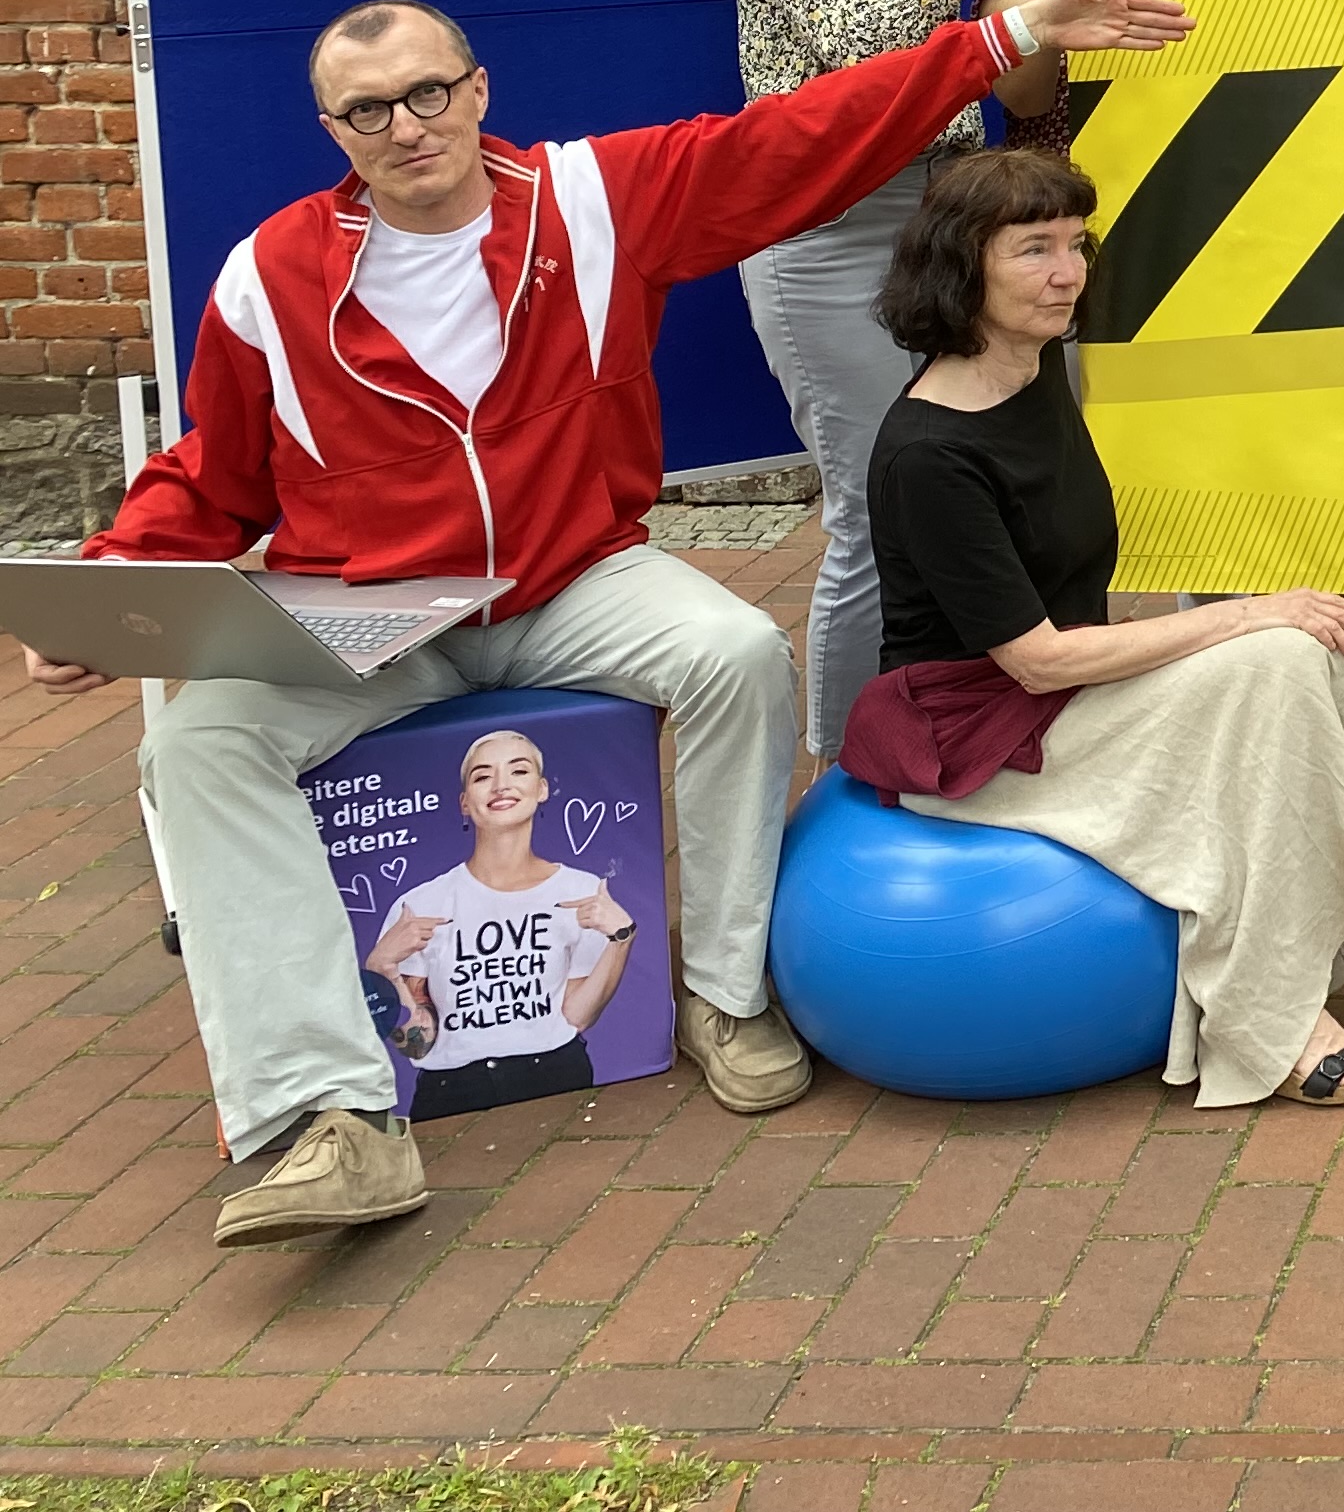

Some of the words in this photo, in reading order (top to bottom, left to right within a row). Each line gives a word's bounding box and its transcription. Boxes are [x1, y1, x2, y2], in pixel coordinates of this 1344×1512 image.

[302, 774, 381, 803] eitere
[333, 791, 439, 827] digitale
[328, 829, 417, 857] etenz.
[456, 913, 552, 962] LOVE
[450, 954, 546, 986] SPEECH
[456, 979, 541, 1009] ENTWI
[444, 994, 551, 1031] CKLERIN
